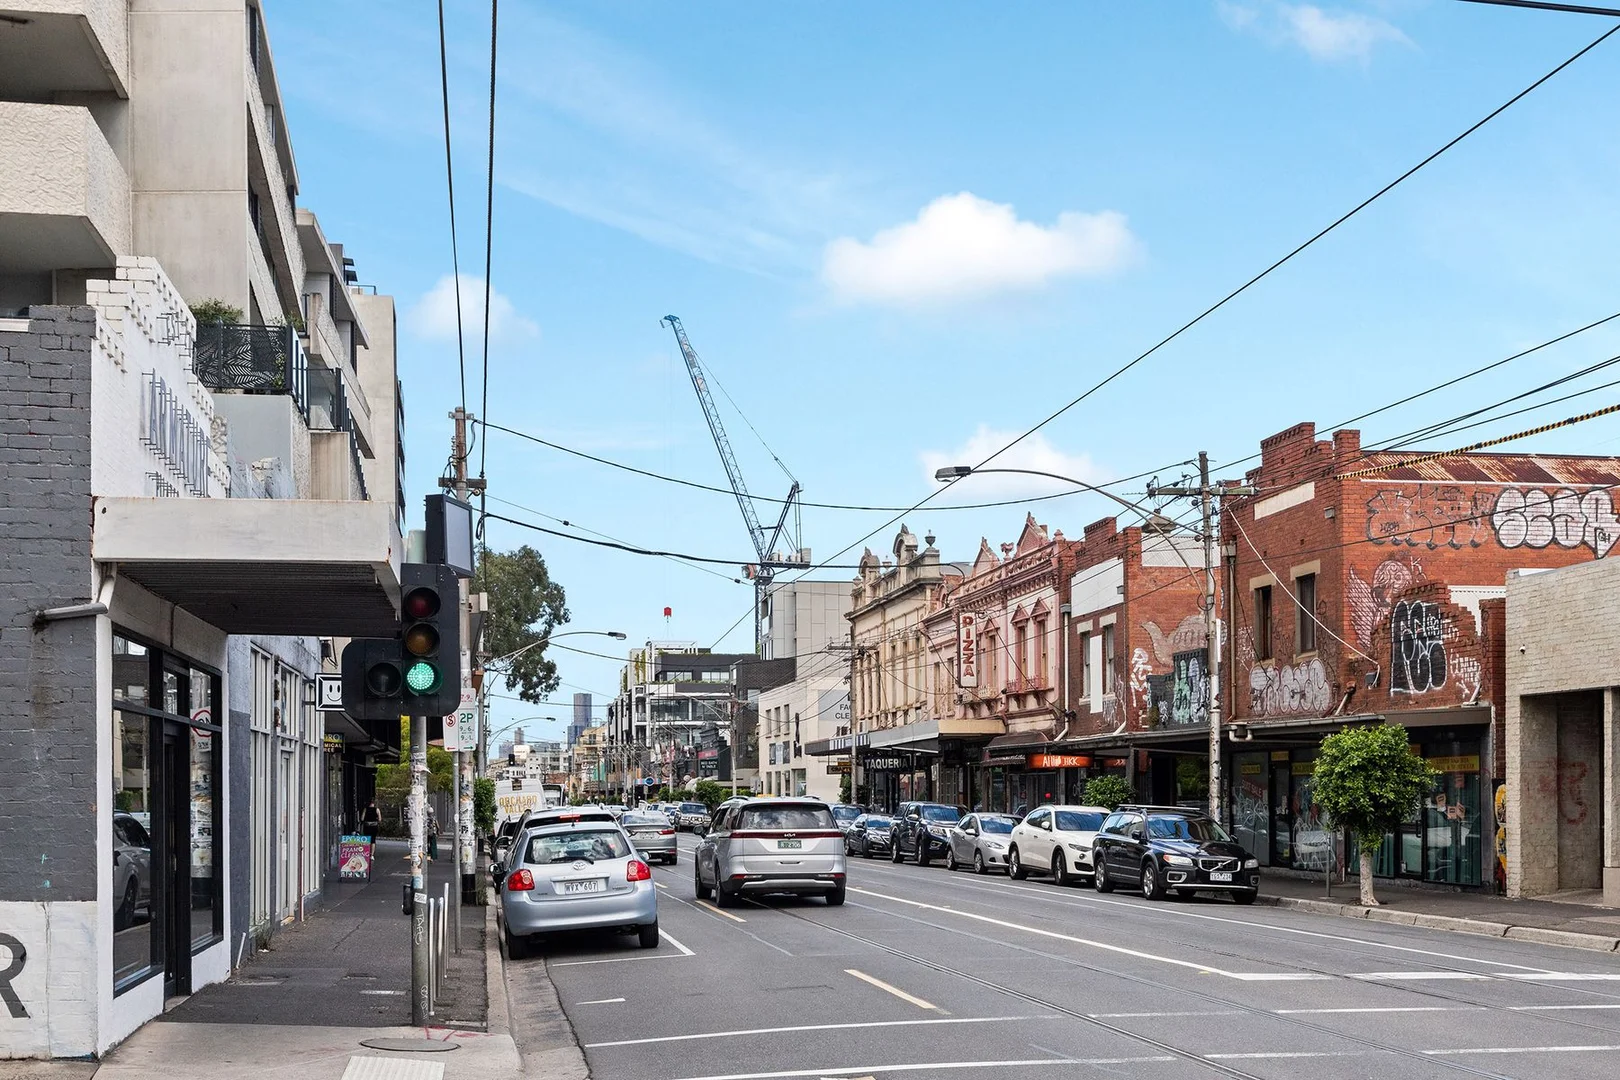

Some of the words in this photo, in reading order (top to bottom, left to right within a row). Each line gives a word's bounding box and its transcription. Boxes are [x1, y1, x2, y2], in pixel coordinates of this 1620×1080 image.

[962, 615, 974, 677] PIZZA
[460, 713, 474, 723] 2P
[865, 758, 908, 769] TAQUERIA
[499, 795, 537, 806] ORCHARD
